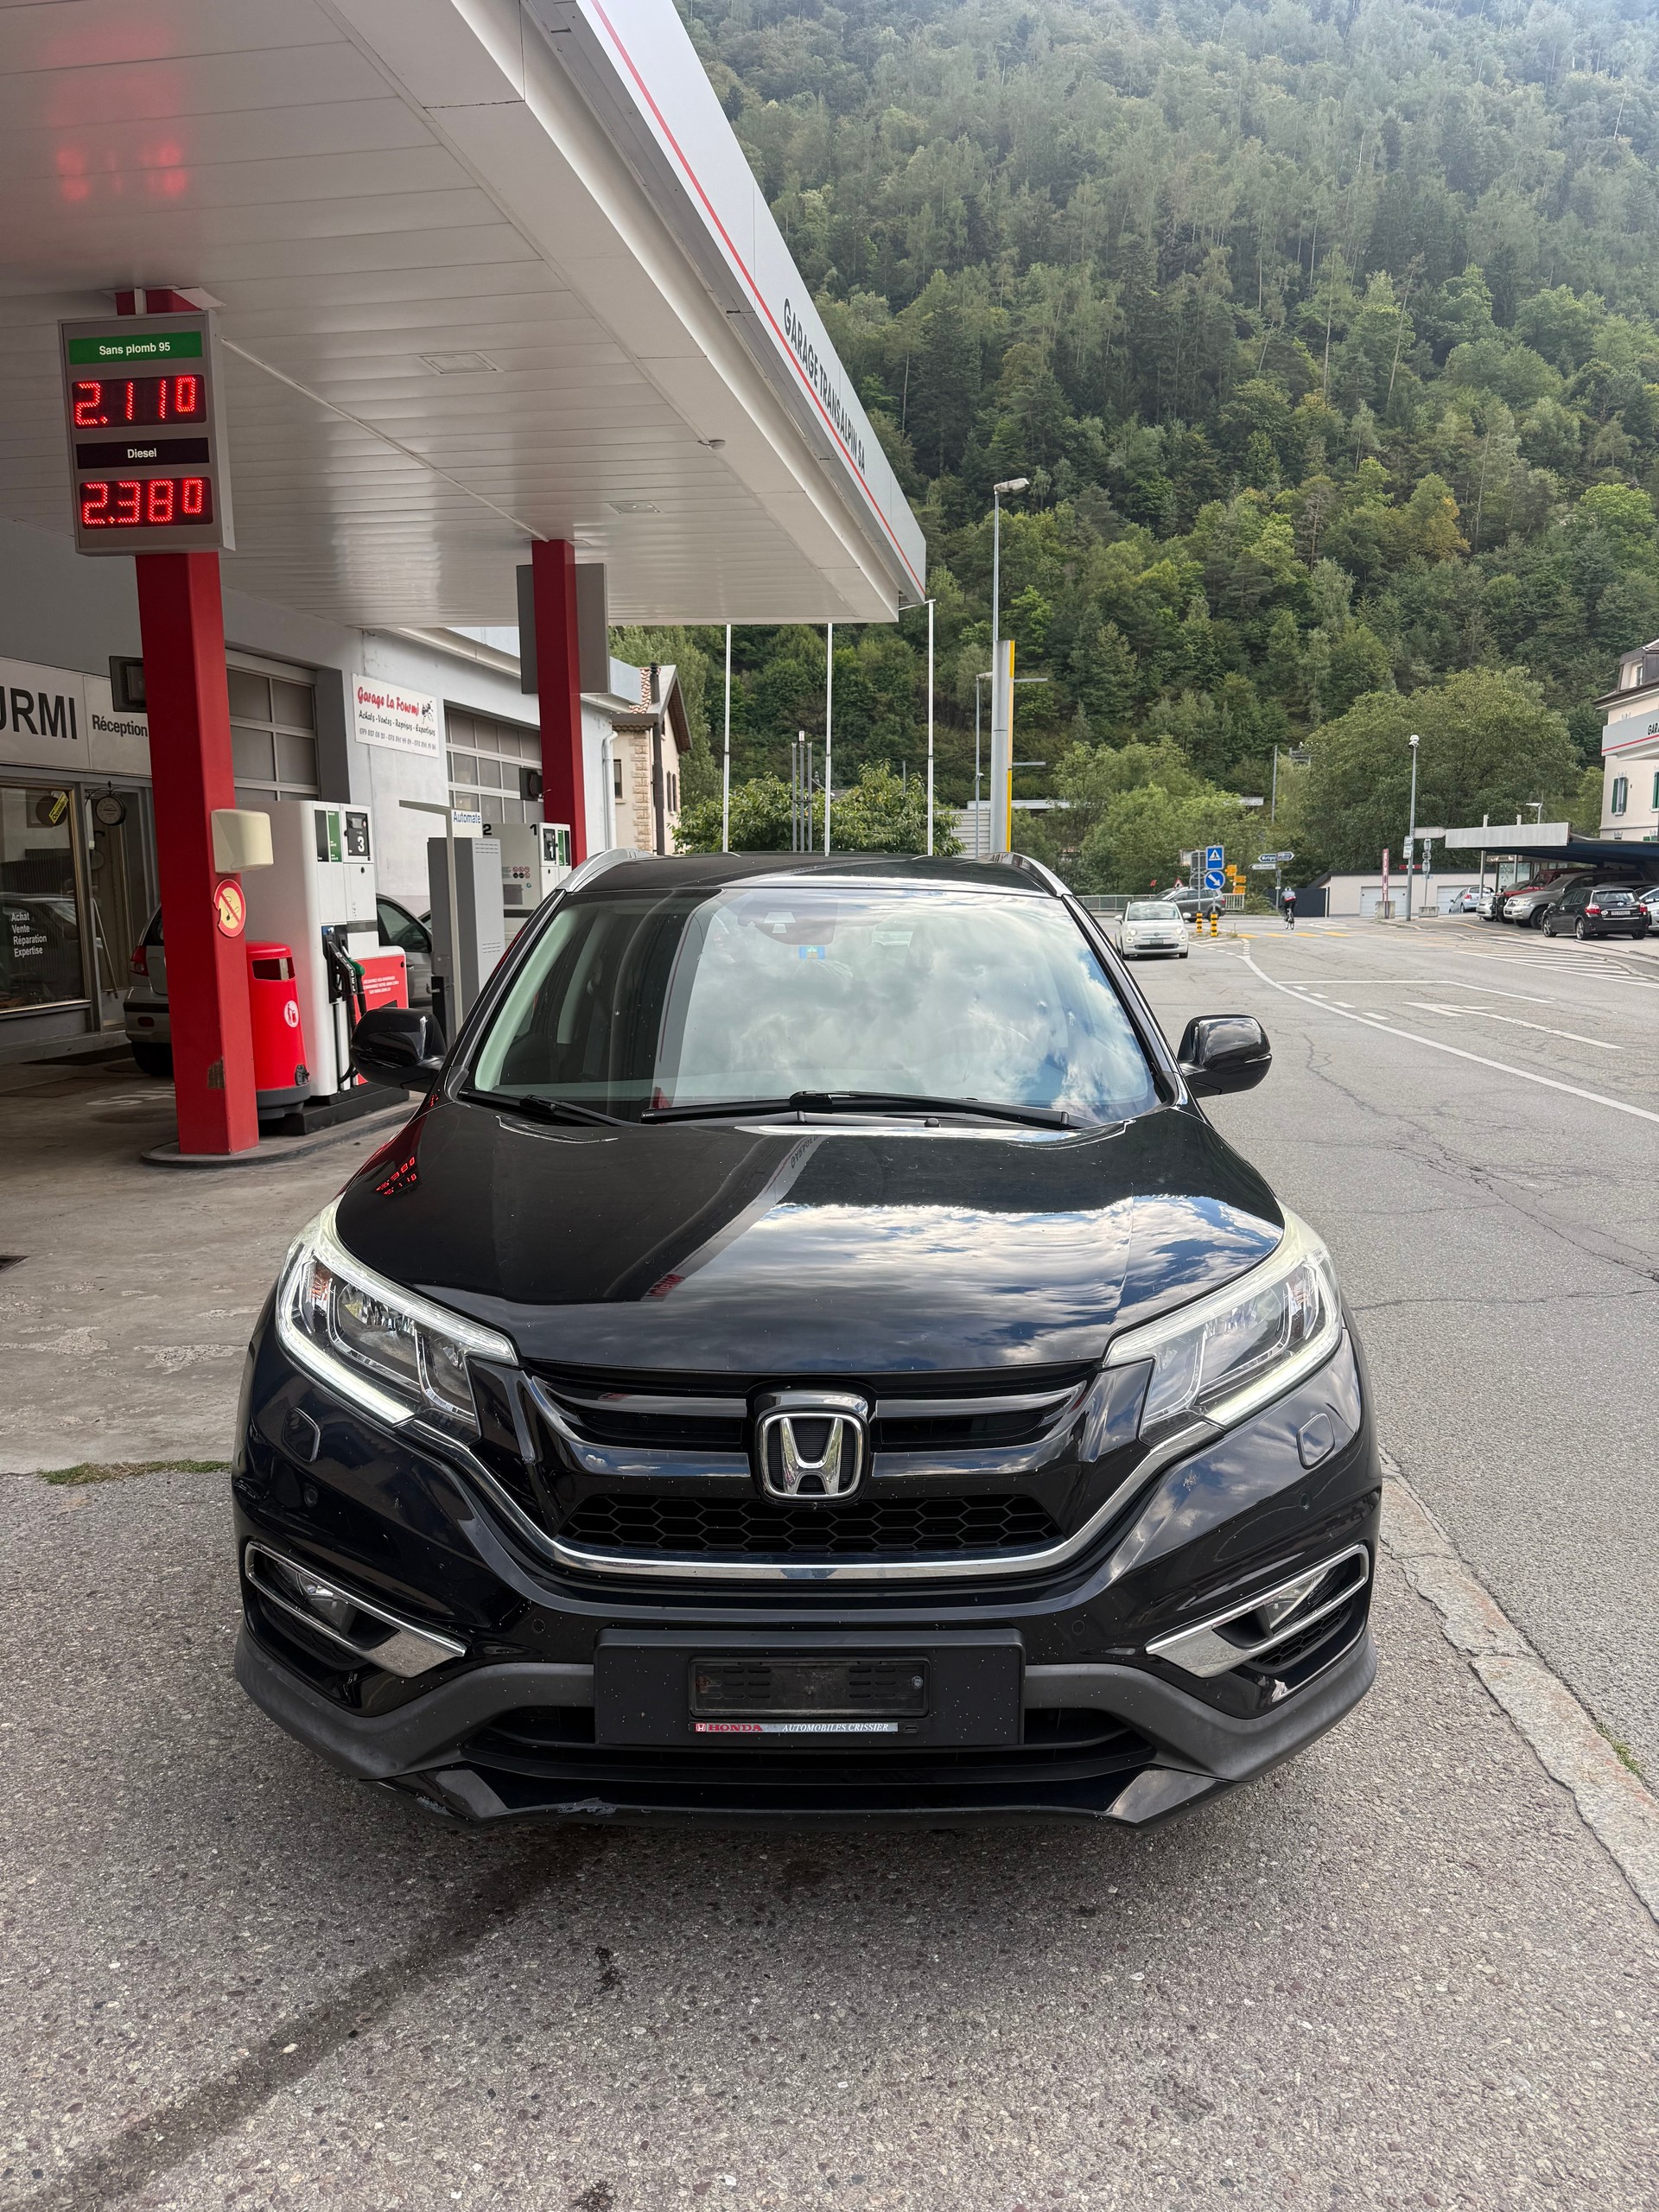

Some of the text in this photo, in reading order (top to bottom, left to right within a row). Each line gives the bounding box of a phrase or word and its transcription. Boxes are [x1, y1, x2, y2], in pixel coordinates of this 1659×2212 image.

[99, 342, 171, 356] Sans plomb 95
[784, 298, 866, 475] GARAGE TRANSALPIN SA
[74, 377, 196, 425] 2.110
[127, 448, 157, 459] Diesel
[84, 479, 203, 524] 2.380
[358, 686, 420, 716] Garage La Fourmi
[359, 710, 375, 723] Achats
[378, 715, 392, 727] Ventes
[92, 715, 149, 737] Réception
[453, 811, 481, 824] Automate
[482, 823, 492, 836] 2
[530, 823, 537, 836] 1
[357, 836, 365, 852] 3
[11, 912, 30, 921] Achat
[11, 925, 30, 933] Vente
[13, 934, 48, 946] Réparation
[14, 946, 43, 958] Expertise
[849, 1723, 889, 1732] CRISSIER
